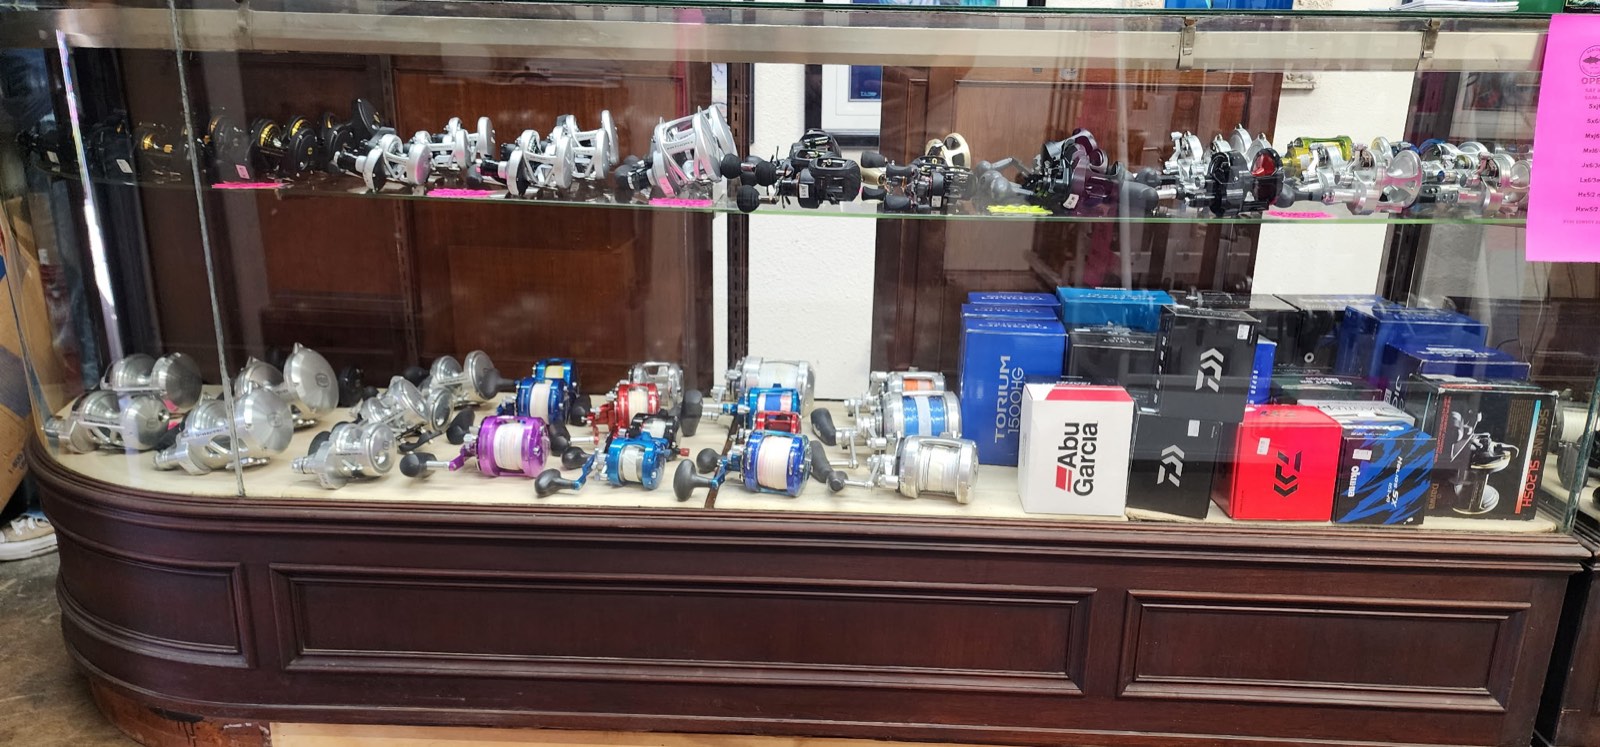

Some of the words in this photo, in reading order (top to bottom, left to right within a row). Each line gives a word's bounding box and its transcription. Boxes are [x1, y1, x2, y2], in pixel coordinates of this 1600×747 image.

[994, 355, 1012, 443] TORIUM
[1007, 367, 1025, 435] 1500HG
[1057, 422, 1081, 469] Abu
[1532, 408, 1549, 457] SEALINE
[1073, 420, 1099, 497] Garcia
[1428, 483, 1440, 510] Daiwa
[1522, 460, 1540, 507] SL20SH
